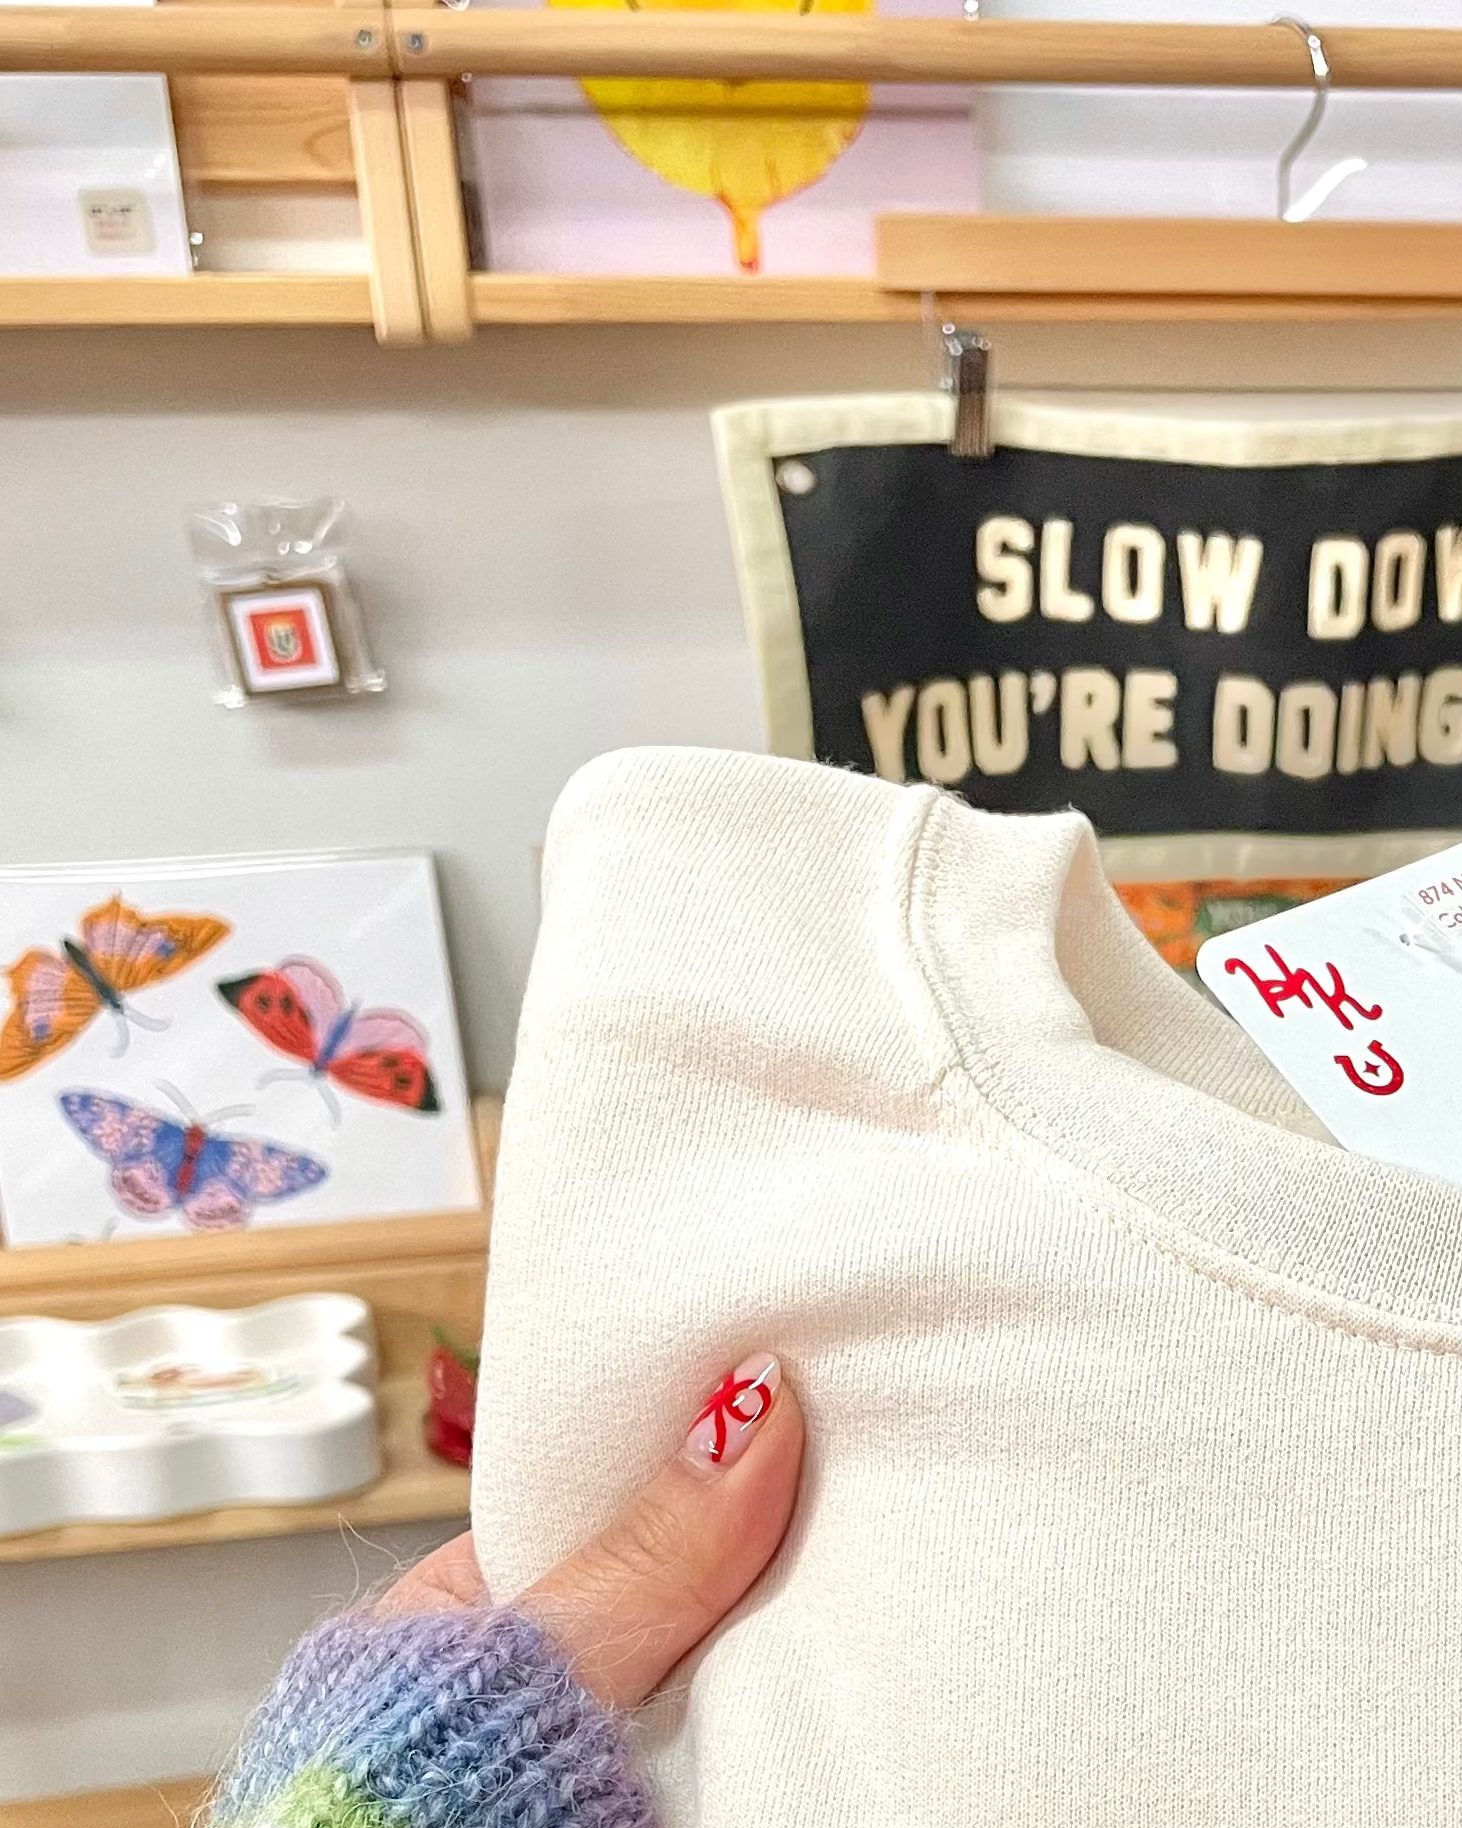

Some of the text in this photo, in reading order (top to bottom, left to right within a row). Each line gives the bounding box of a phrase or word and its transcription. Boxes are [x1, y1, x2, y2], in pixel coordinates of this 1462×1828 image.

[976, 515, 1264, 635] SLOW
[861, 665, 1179, 785] YOU'RE
[1418, 881, 1454, 906] 874
